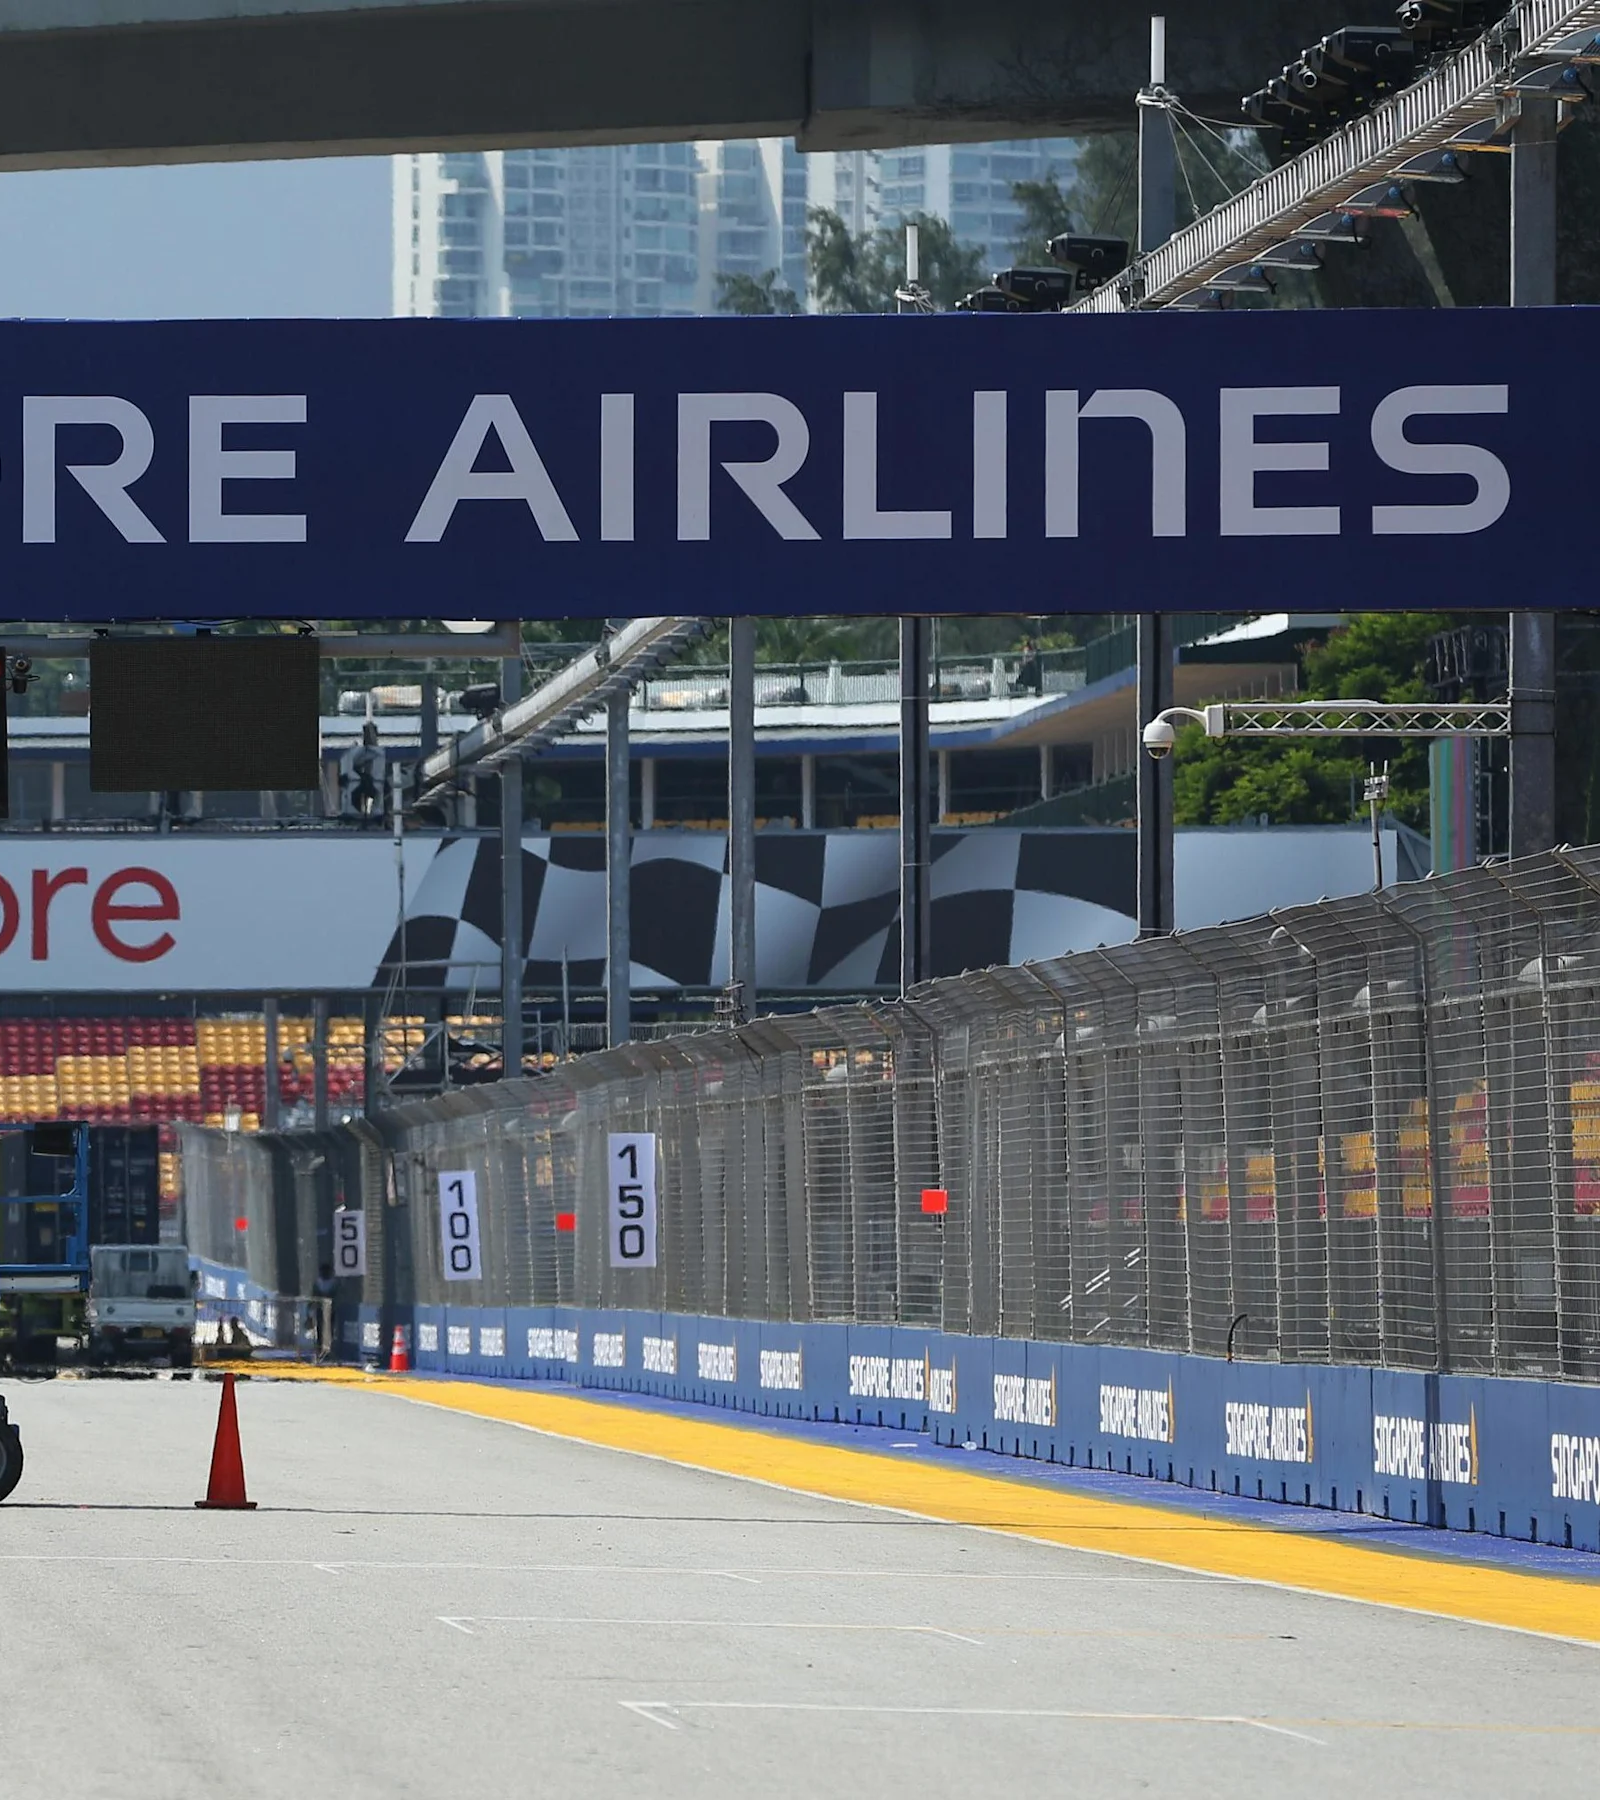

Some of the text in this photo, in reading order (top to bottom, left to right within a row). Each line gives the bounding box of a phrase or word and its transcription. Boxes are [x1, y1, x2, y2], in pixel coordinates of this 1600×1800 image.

[405, 384, 1511, 543] AIRLINES
[1225, 1402, 1270, 1460] SINGAPORE
[1373, 1415, 1472, 1484] SINGAPORE AIRLINES
